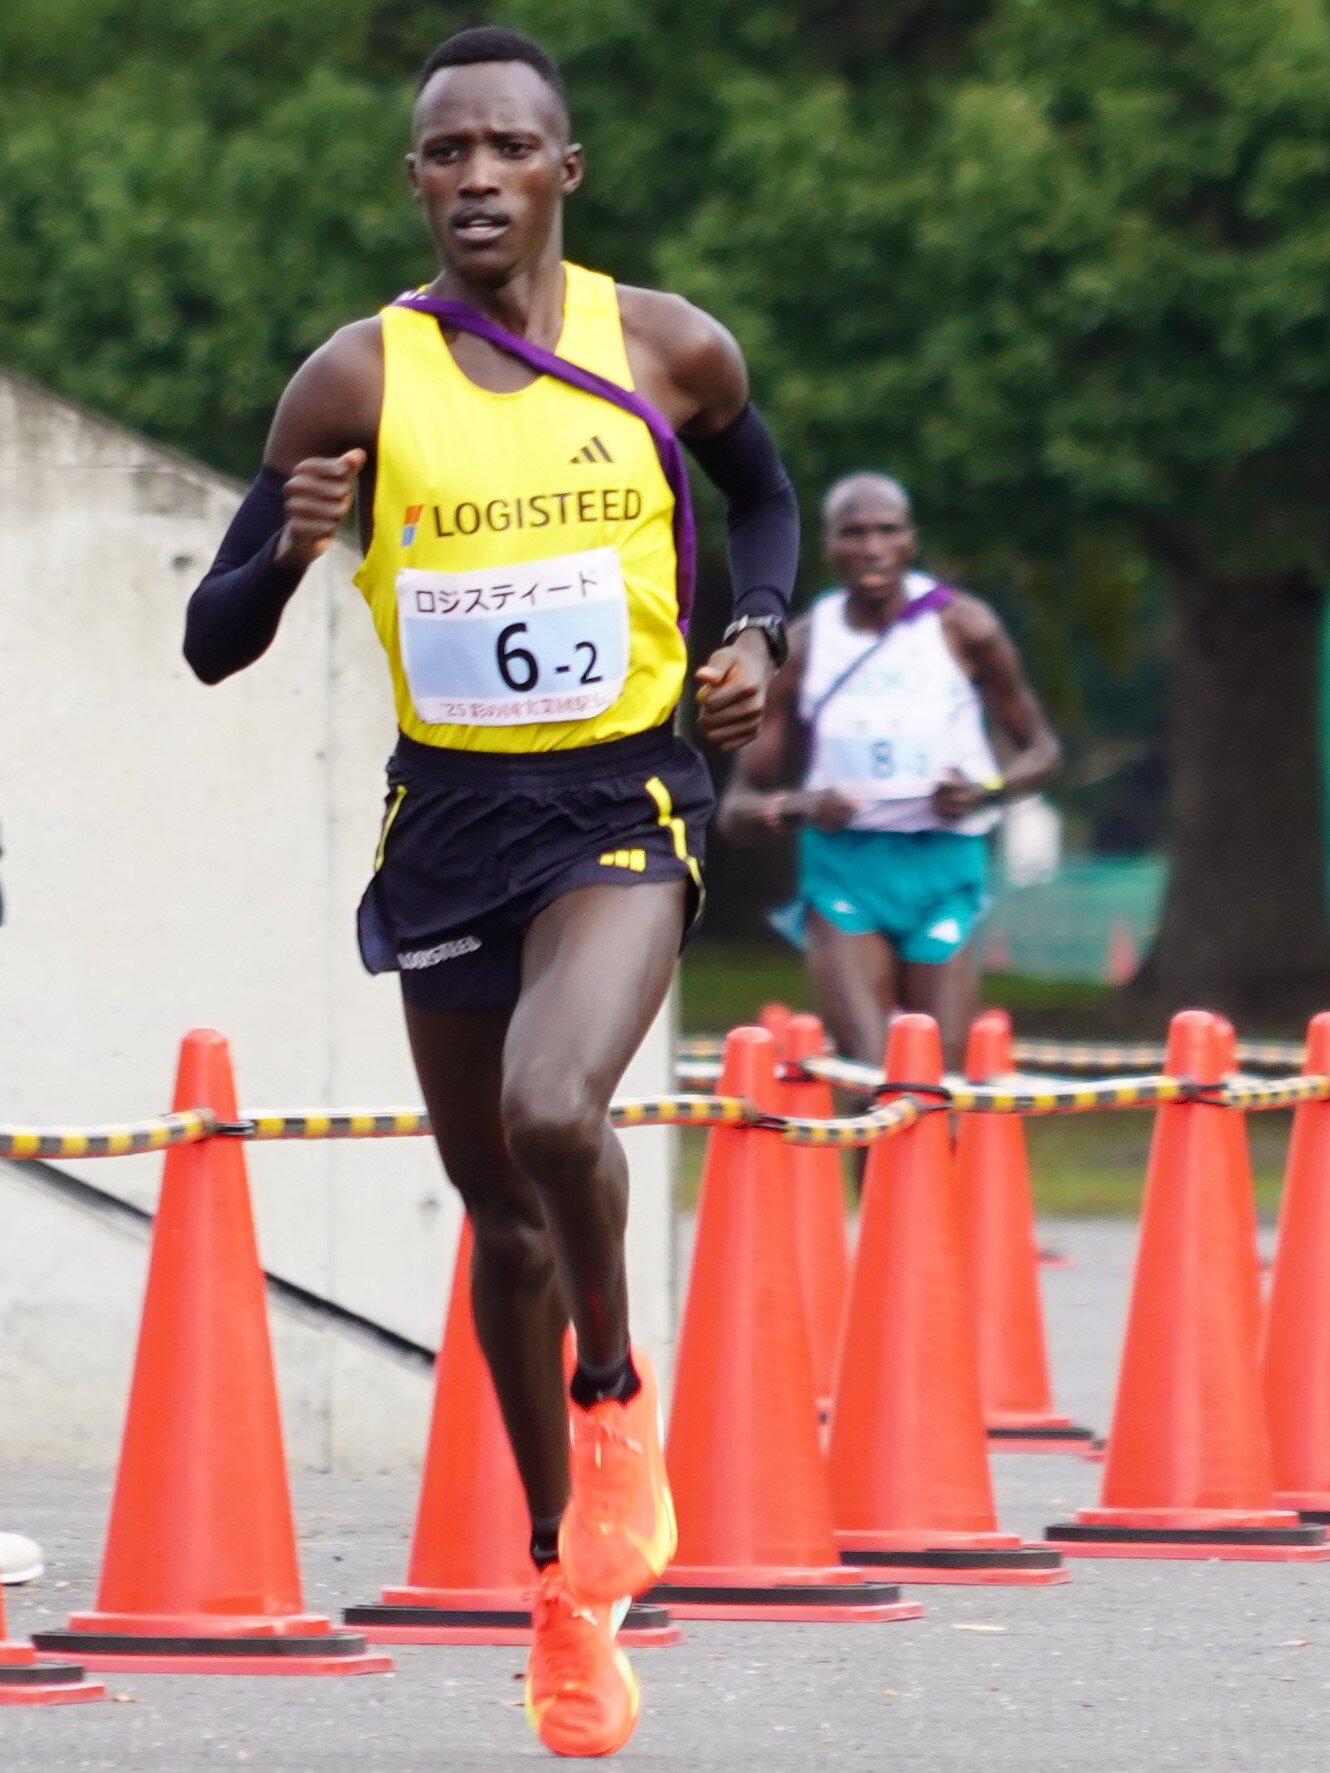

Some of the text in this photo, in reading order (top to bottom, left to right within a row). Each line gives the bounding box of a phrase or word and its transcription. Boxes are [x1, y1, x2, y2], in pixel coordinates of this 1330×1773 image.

[433, 488, 642, 538] LOGISTEED
[416, 570, 598, 614] ロジスティード
